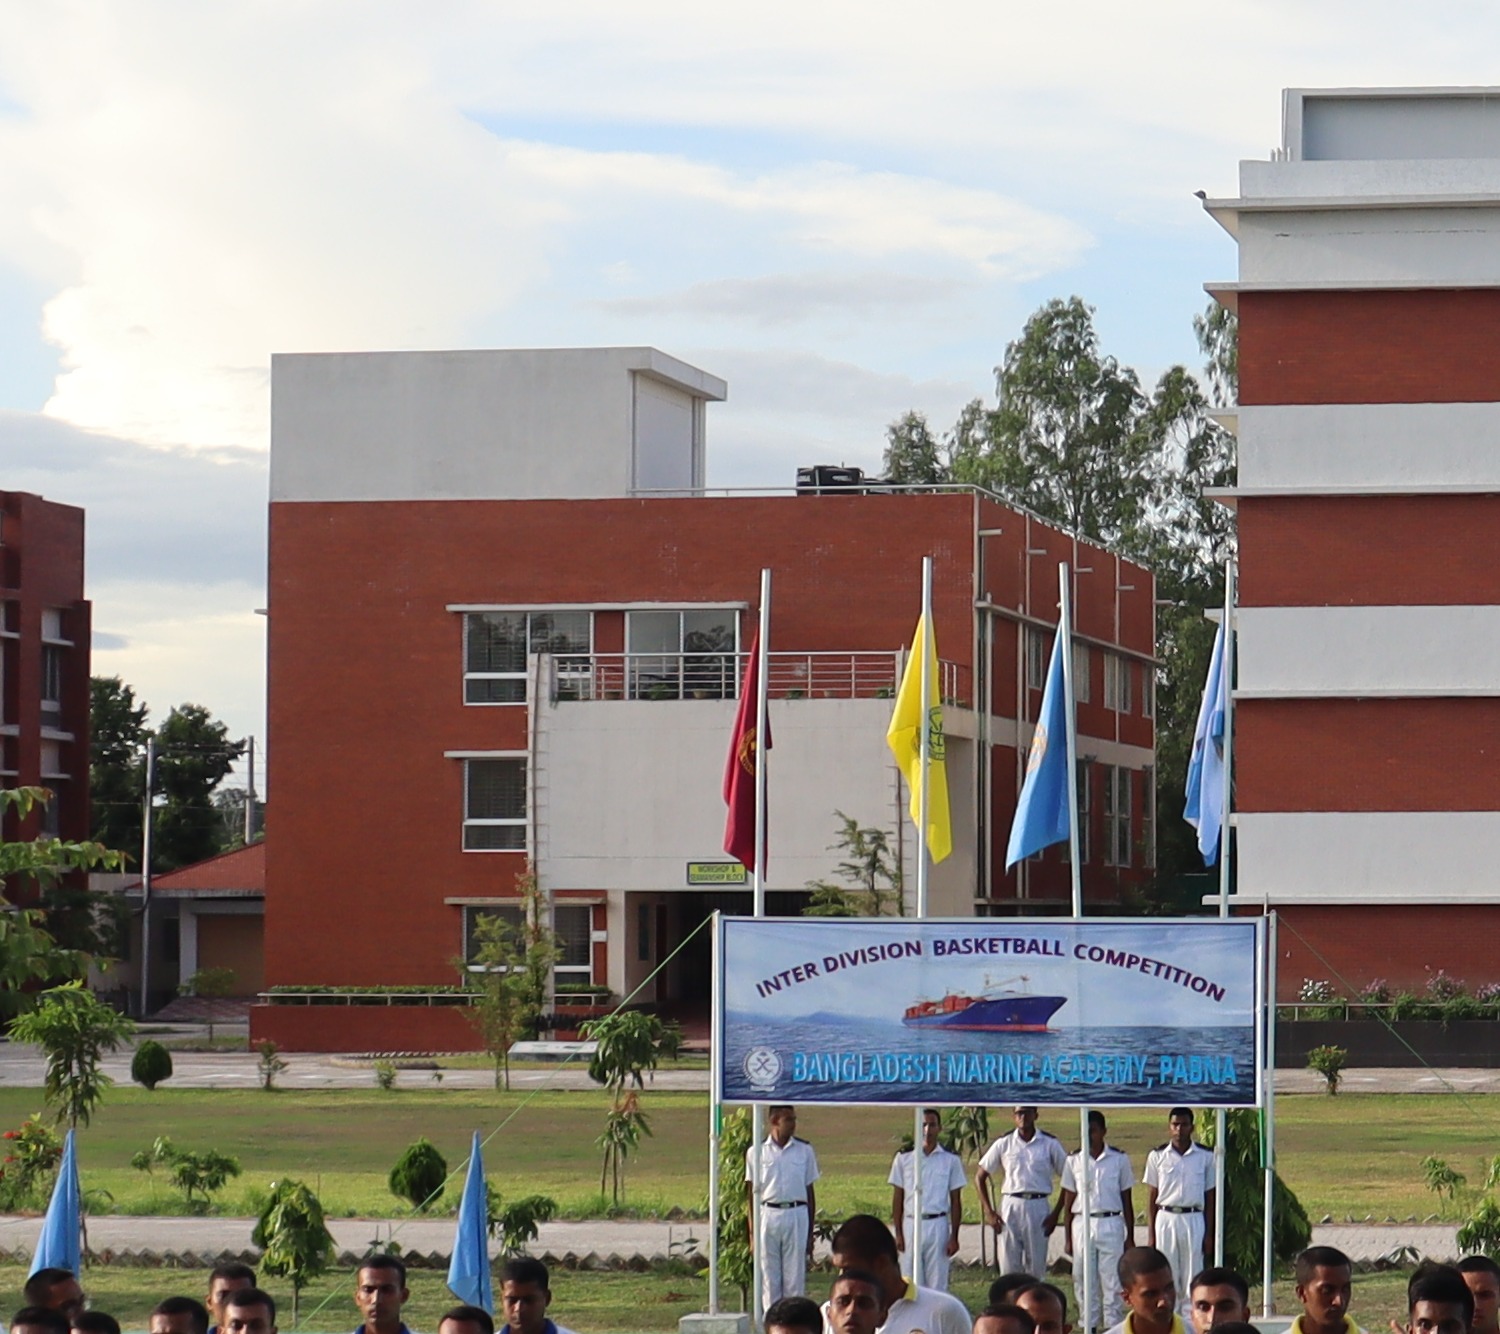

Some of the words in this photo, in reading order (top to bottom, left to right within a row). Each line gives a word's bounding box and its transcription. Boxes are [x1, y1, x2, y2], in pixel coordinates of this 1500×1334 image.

[697, 865, 730, 873] WORKSHOP
[755, 962, 820, 999] INTER
[822, 940, 922, 974] DIVISION
[932, 937, 1066, 957] BASKETBALL
[1073, 943, 1227, 1002] COMPETITION
[791, 1050, 941, 1084] BANGLADESH
[947, 1052, 1035, 1085] MARINE
[1039, 1053, 1154, 1089] ACADEMY,
[1158, 1054, 1238, 1085] PABNA
